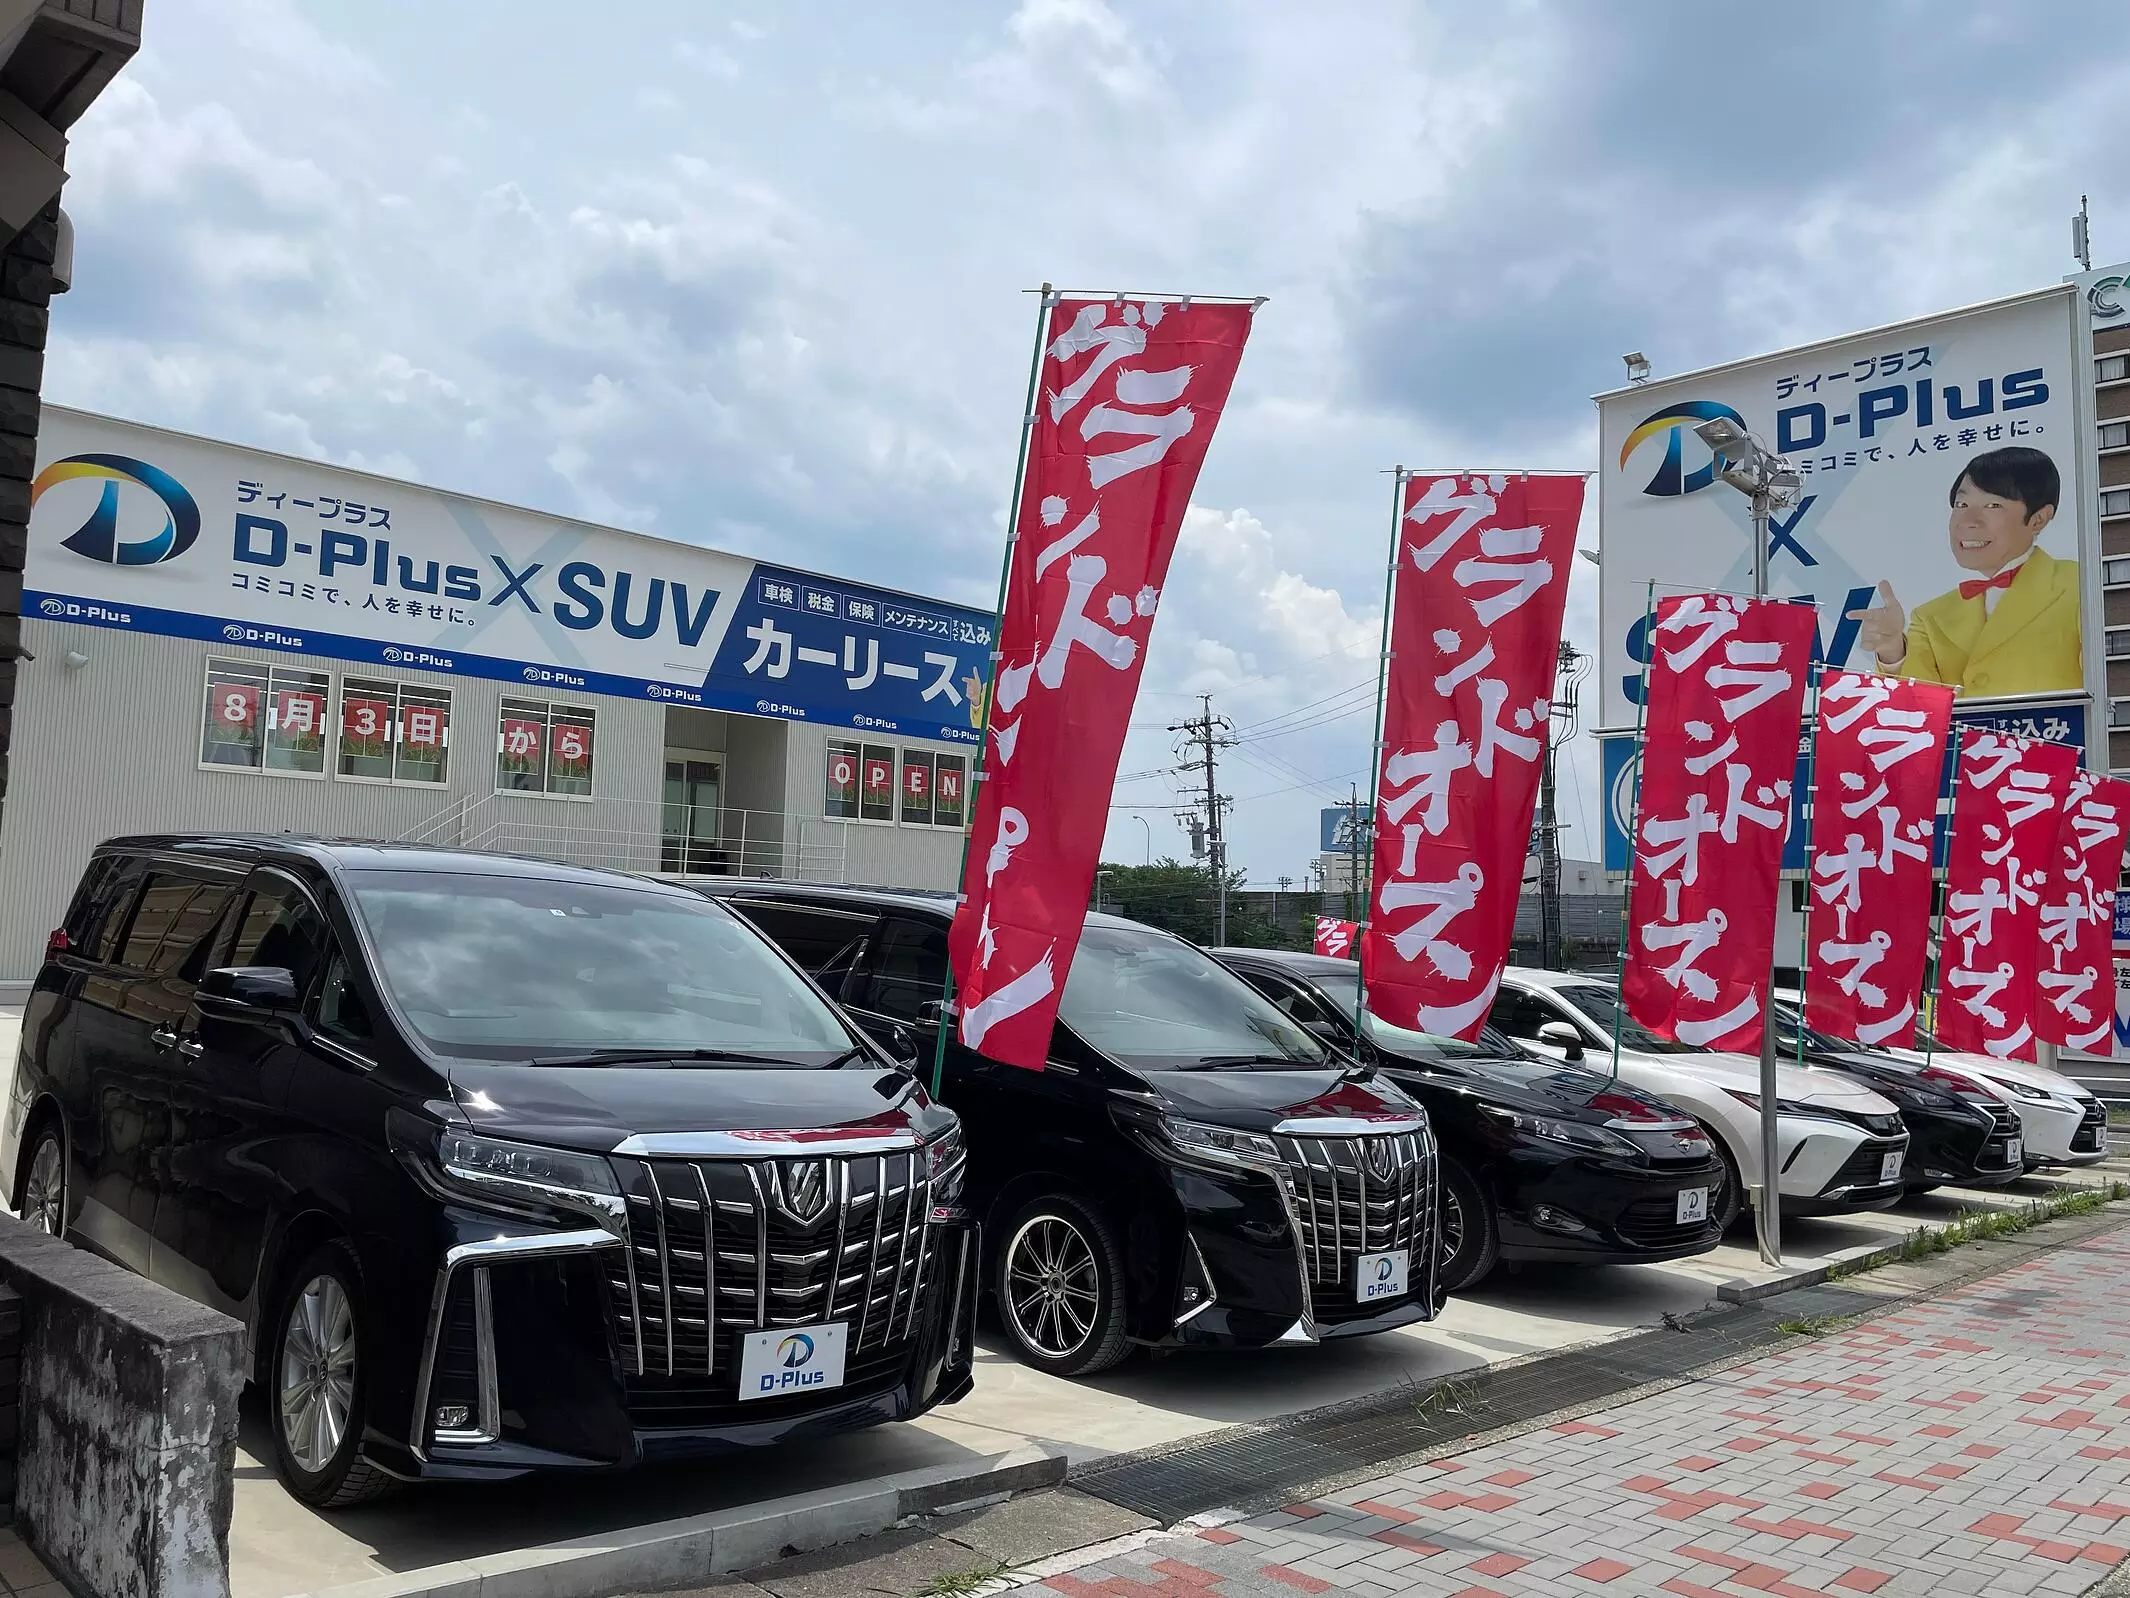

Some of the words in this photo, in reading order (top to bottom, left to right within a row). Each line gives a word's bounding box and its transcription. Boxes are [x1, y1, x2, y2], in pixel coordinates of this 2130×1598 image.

[1776, 346, 1933, 400] ディープラス
[1776, 368, 2050, 454] D-Plus
[1799, 420, 2045, 475] ミコミで、人を幸せに。
[237, 480, 391, 531] ディープラス
[232, 572, 475, 626] コミコミで、人を幸せに。
[233, 512, 482, 602] D-Plus
[553, 561, 721, 647] SUV
[66, 603, 131, 623] D-Plus
[764, 583, 794, 605] 車検
[807, 592, 835, 613] 税金
[848, 600, 875, 621] 保険
[884, 609, 950, 636] メンテナンス
[245, 630, 303, 648] D-Plus
[403, 651, 453, 668] D-Plus
[742, 617, 964, 708] カーリース
[541, 670, 585, 686] D-Plus
[662, 687, 702, 702] D-Plus
[961, 302, 1202, 1050] グランドン
[770, 703, 806, 717] D-Plus
[865, 716, 897, 730] D-Plus
[1378, 476, 1553, 1037] グランドオープン
[1637, 596, 1794, 1046] グランドオープン
[1811, 675, 1936, 1046] グランドオープン
[1948, 734, 2055, 1060] グランドオープン
[1367, 1282, 1399, 1297] D-Plus
[760, 1371, 825, 1391] D-Plus
